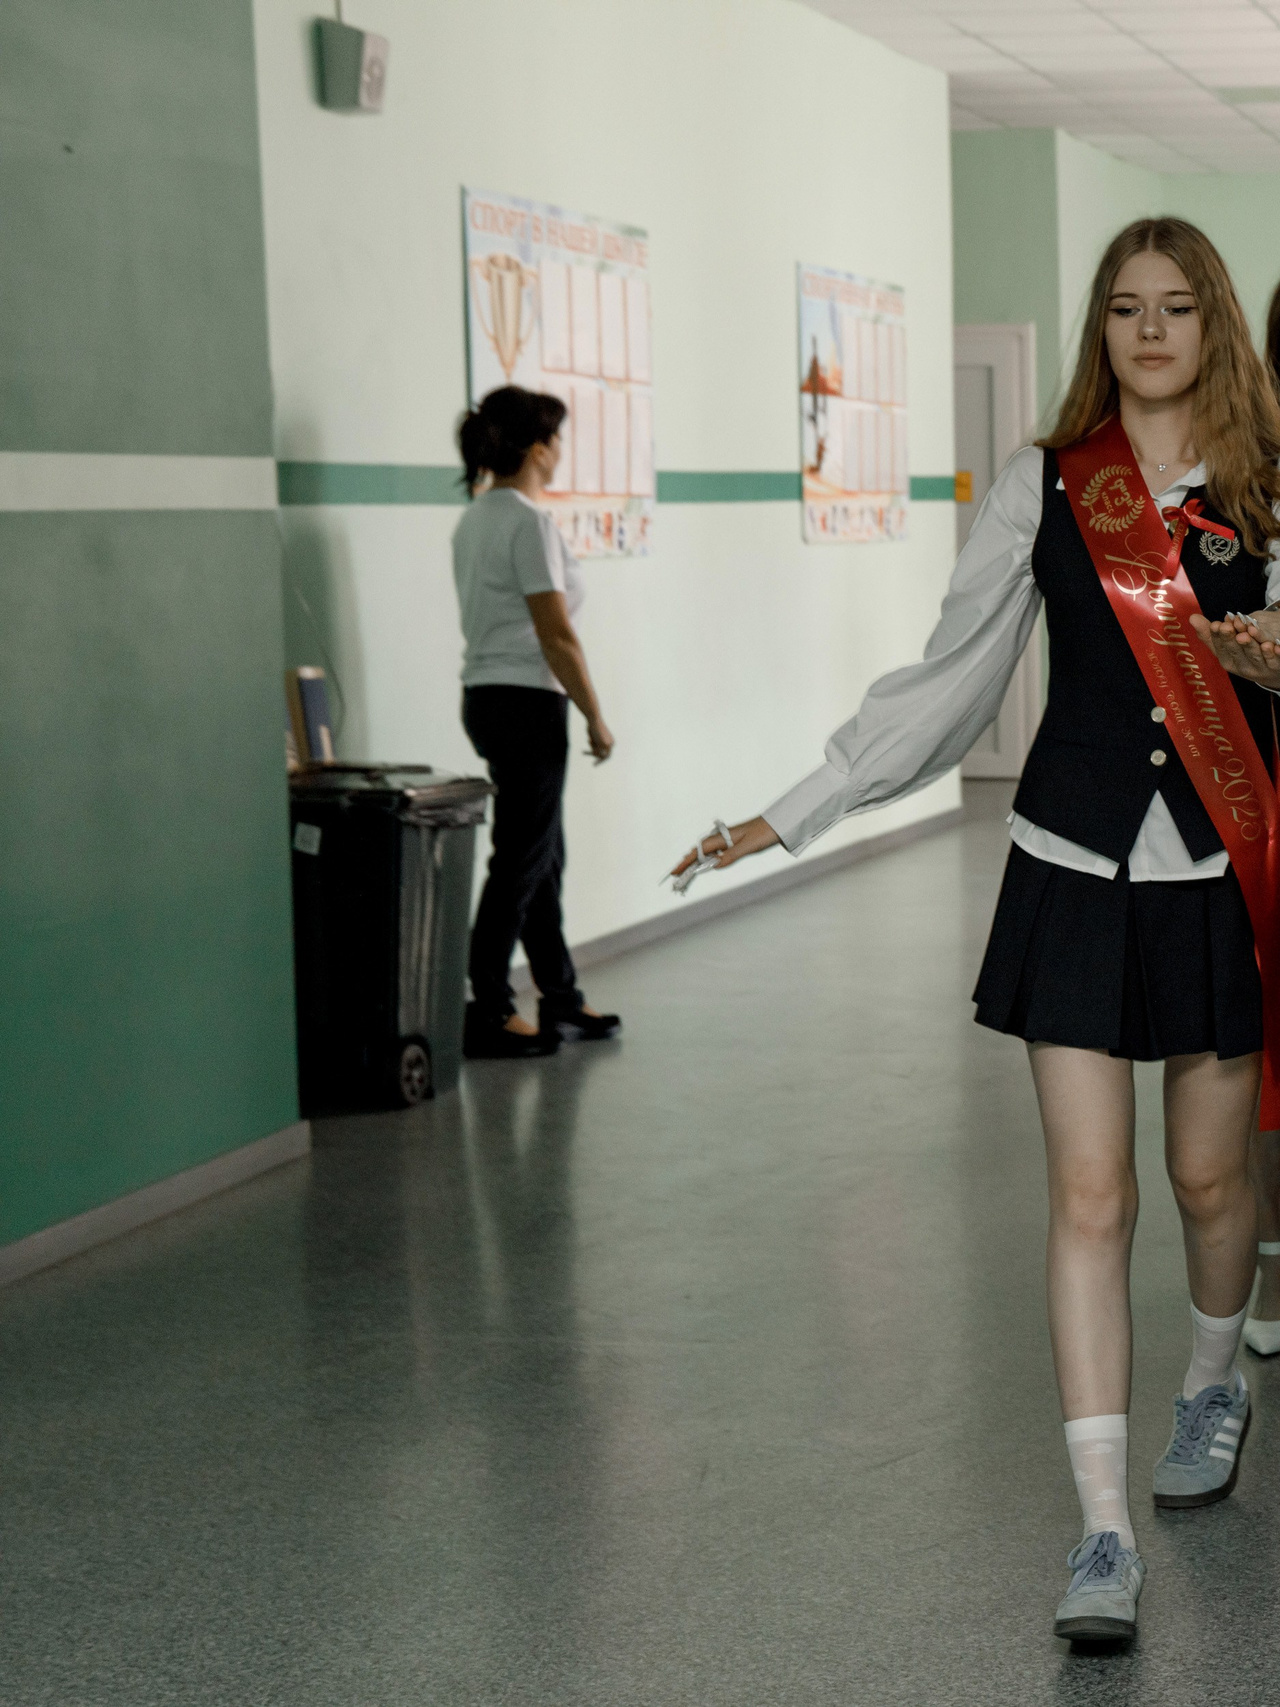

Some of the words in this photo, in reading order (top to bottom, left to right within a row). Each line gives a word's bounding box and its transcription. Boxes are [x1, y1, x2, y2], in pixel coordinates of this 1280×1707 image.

[470, 200, 528, 240] СПОРТ
[531, 213, 544, 245] В
[1101, 491, 1115, 514] класс
[1104, 531, 1235, 757] Выпускница
[1188, 743, 1201, 758] 107
